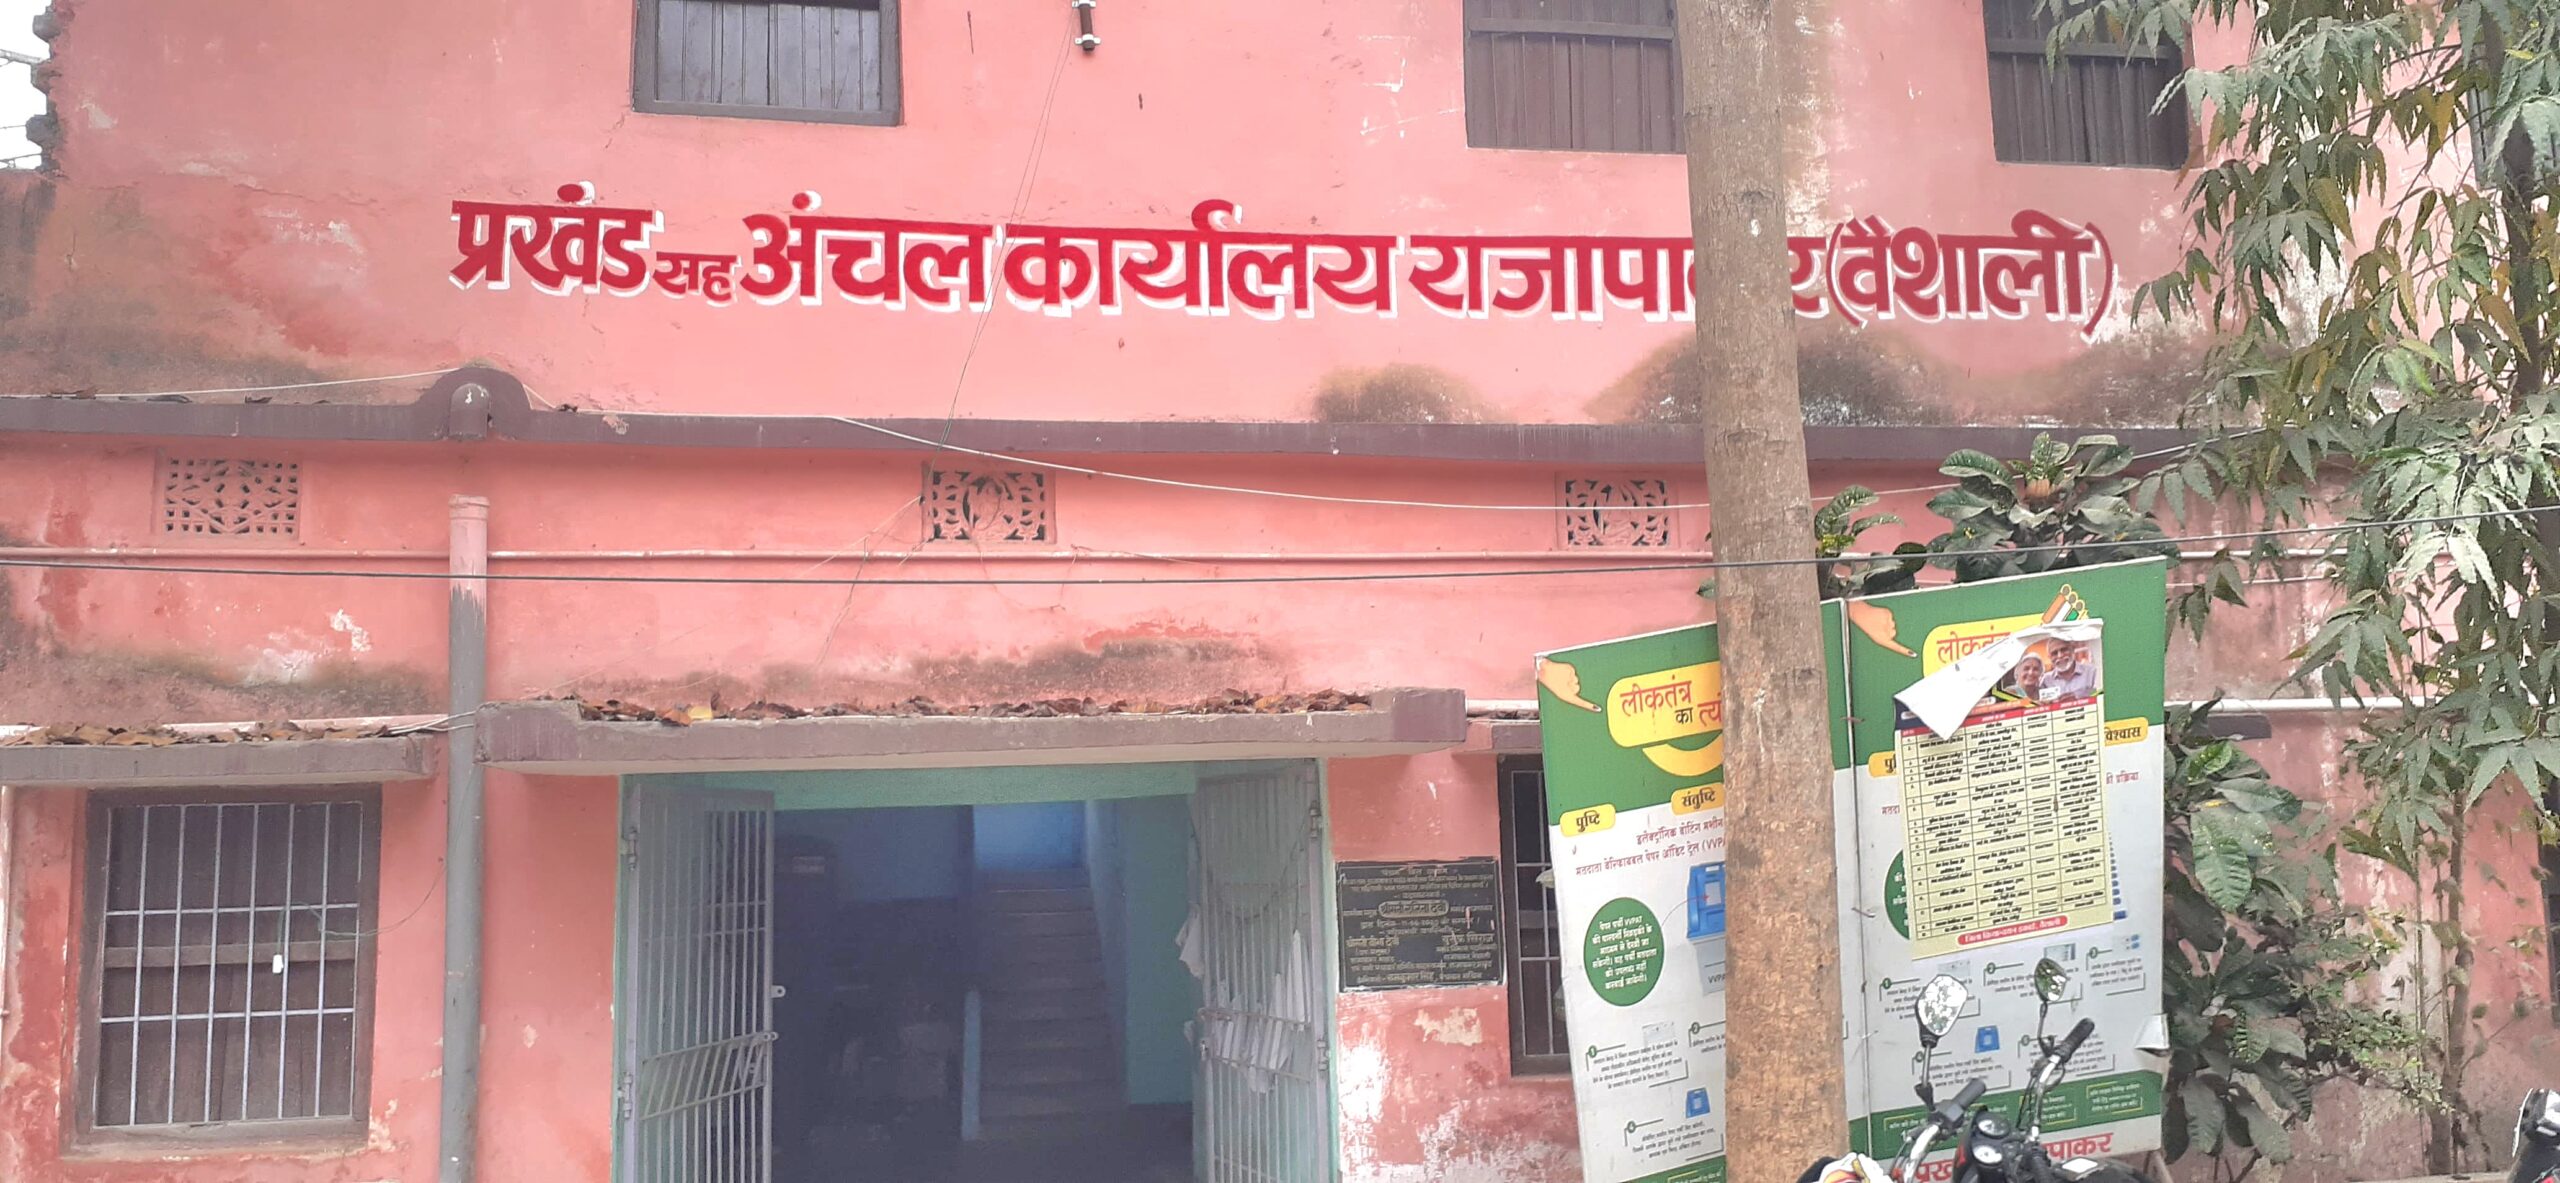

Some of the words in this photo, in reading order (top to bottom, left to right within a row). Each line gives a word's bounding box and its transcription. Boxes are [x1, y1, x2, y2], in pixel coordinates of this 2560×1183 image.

[451, 183, 661, 289] प्रखंड
[652, 248, 740, 304] सह
[740, 191, 1000, 310] अंचल
[1004, 200, 1402, 320] कार्यालय
[1406, 234, 1826, 322] राजापार
[1825, 209, 2112, 340] (वैशाली)
[1619, 675, 1693, 717] लोकतंत्र
[1675, 708, 1694, 725] का
[1682, 787, 1716, 810] संतुष्टि
[1576, 810, 1600, 833] पुष्टि
[1576, 862, 1602, 876] मतदाता
